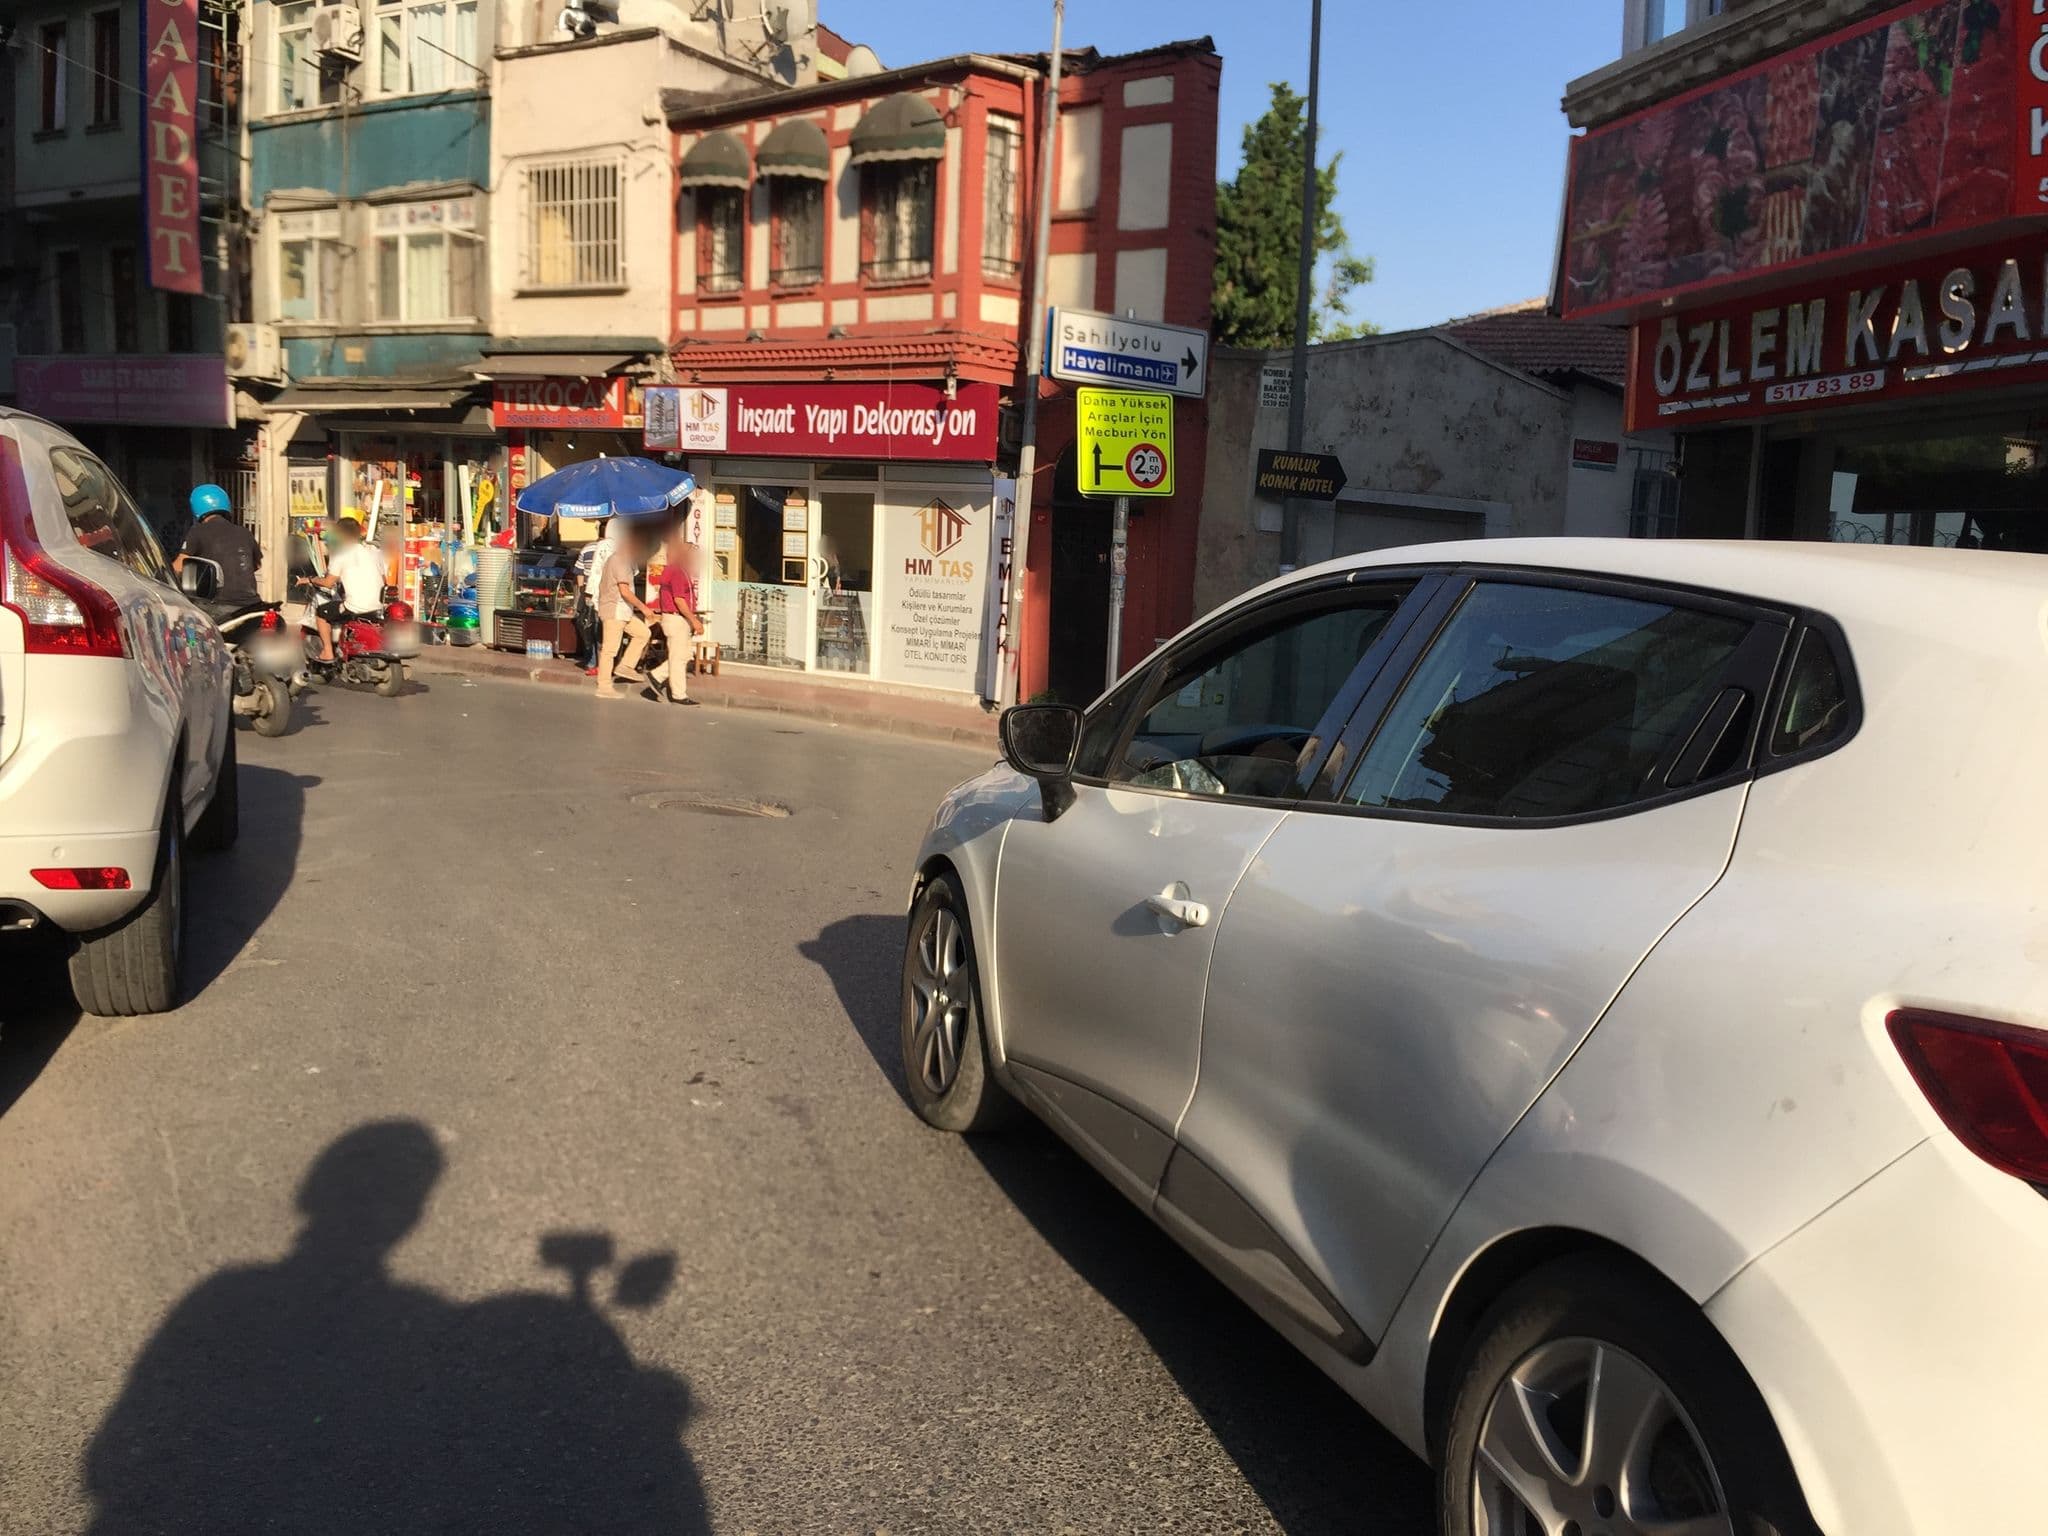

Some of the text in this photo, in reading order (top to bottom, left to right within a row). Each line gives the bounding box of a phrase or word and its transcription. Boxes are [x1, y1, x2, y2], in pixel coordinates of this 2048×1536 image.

[151, 0, 193, 274] AADET
[1064, 325, 1161, 352] Sahilyolu
[1654, 299, 1826, 397] ÖZLEM
[1064, 350, 1160, 380] Havalimanı
[1773, 372, 1877, 400] 517 83 89
[498, 382, 618, 412] TEKOCAN
[1083, 396, 1167, 409] Daha Yüksek
[685, 422, 700, 432] HM
[737, 397, 976, 446] İnşaat Yapı Dekorasyon
[1088, 411, 1163, 426] Araçlar İçin
[689, 434, 715, 443] GROUP
[1085, 426, 1167, 439] Mecburi Yön
[1272, 455, 1321, 474] KUMLUK
[1259, 472, 1334, 494] KONAK HOTEL
[904, 557, 974, 583] HM TAŞ
[932, 590, 967, 601] tasarımlar
[996, 537, 1013, 655] EMLAK
[901, 599, 974, 614] Kişilere ve Kurumlara
[912, 612, 961, 626] Özel çözümler
[890, 624, 919, 636] Konsept
[919, 626, 953, 639] Uygulama
[903, 649, 922, 661] OTEL
[923, 651, 950, 663] KONUT
